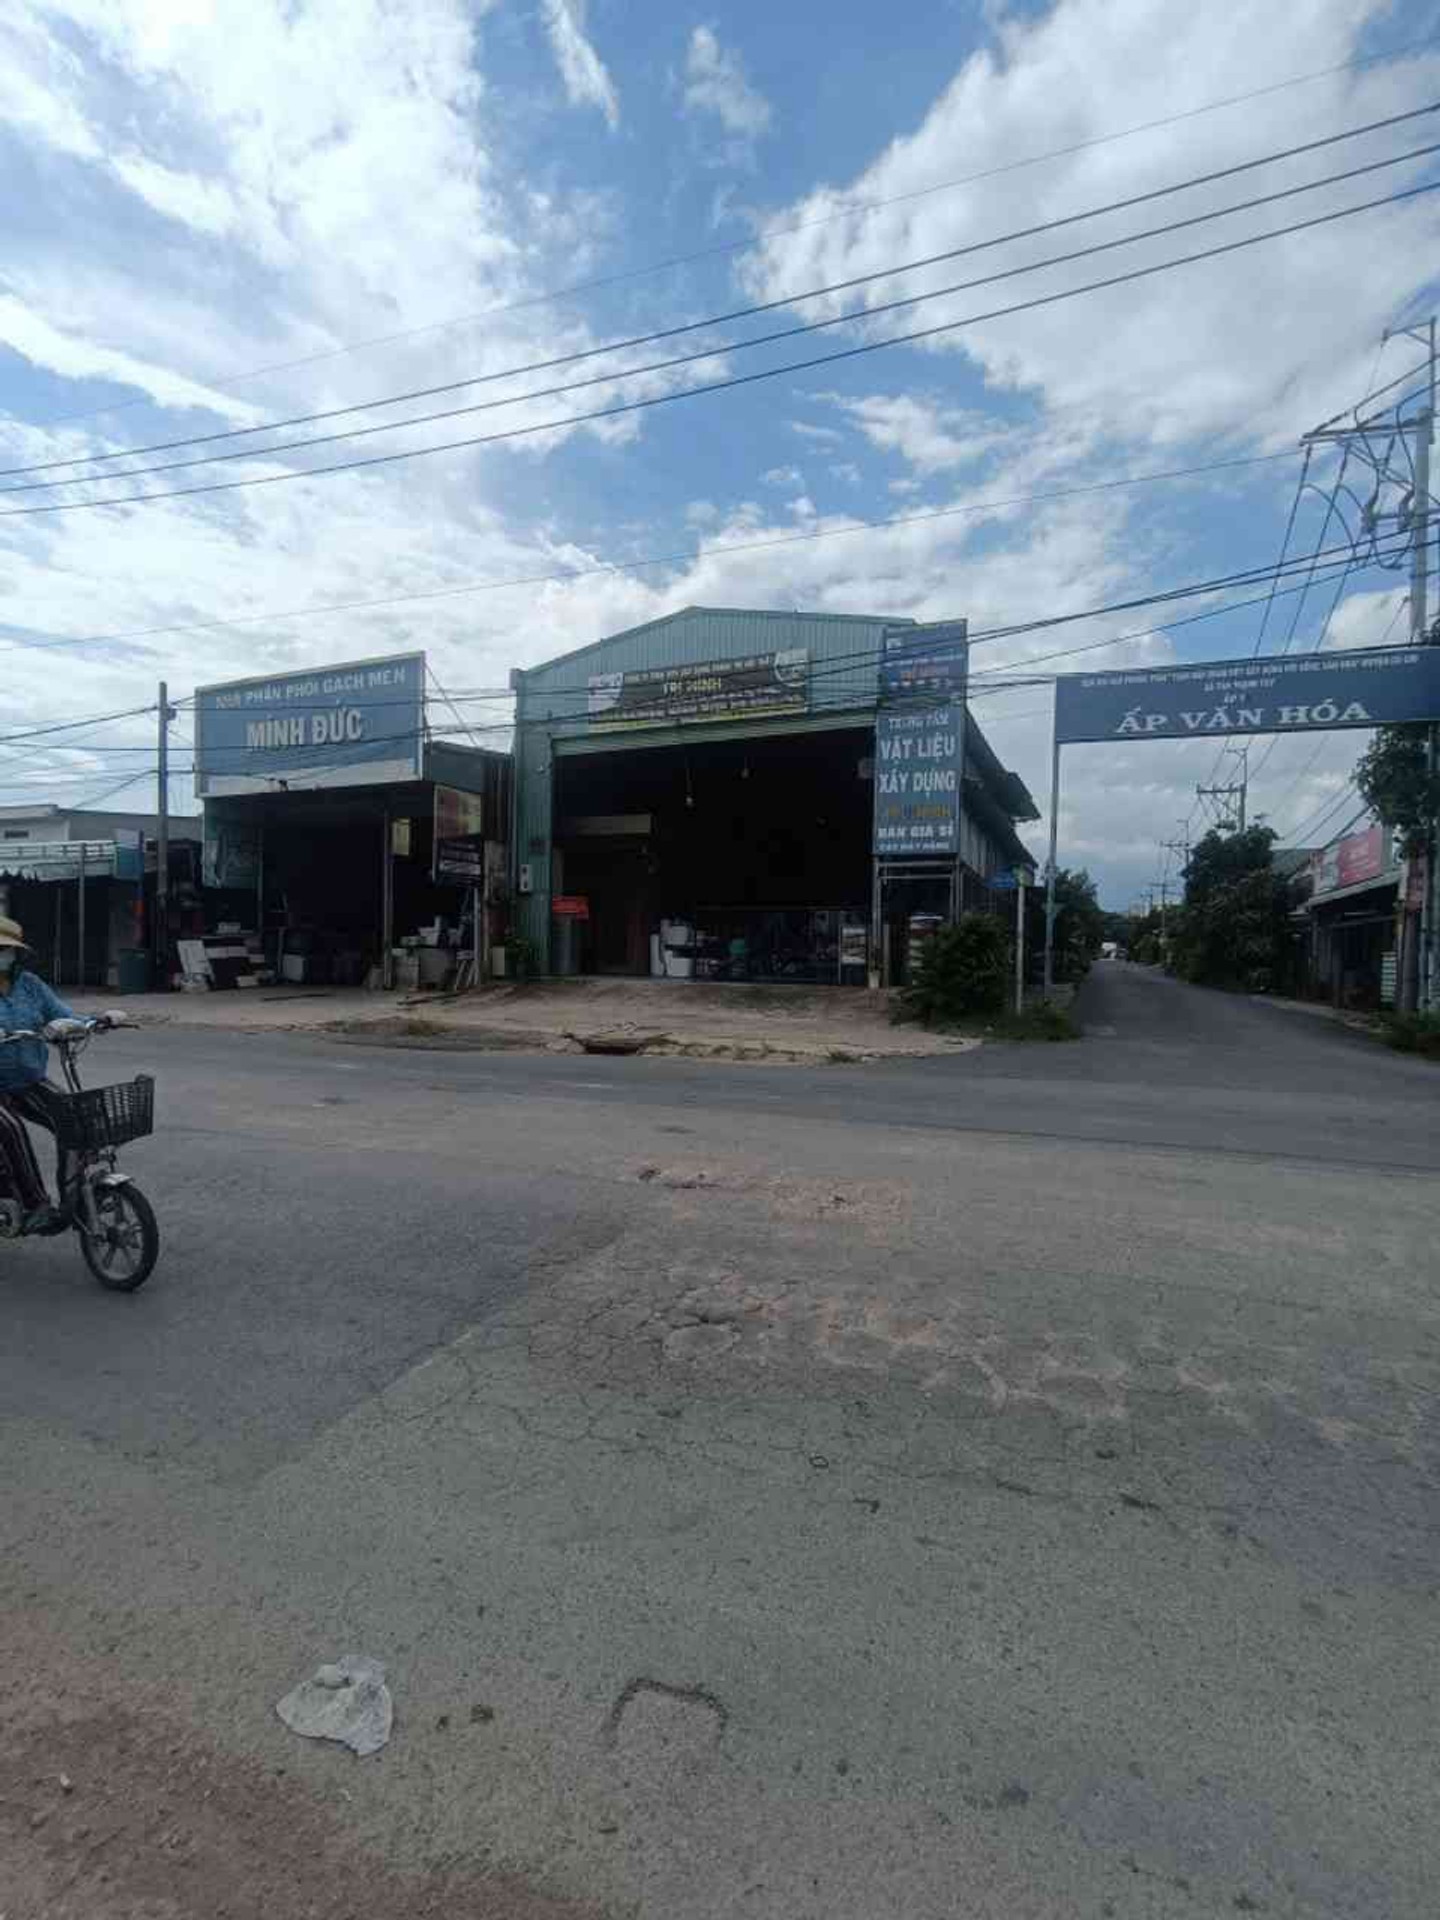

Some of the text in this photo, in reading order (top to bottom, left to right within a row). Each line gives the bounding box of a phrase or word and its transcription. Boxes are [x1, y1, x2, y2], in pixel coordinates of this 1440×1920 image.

[312, 698, 361, 744] ĐỨC
[1116, 698, 1372, 733] ẤP VĂN HÓA
[880, 732, 955, 764] VẬT LIỆU
[913, 769, 955, 799] DỰNG
